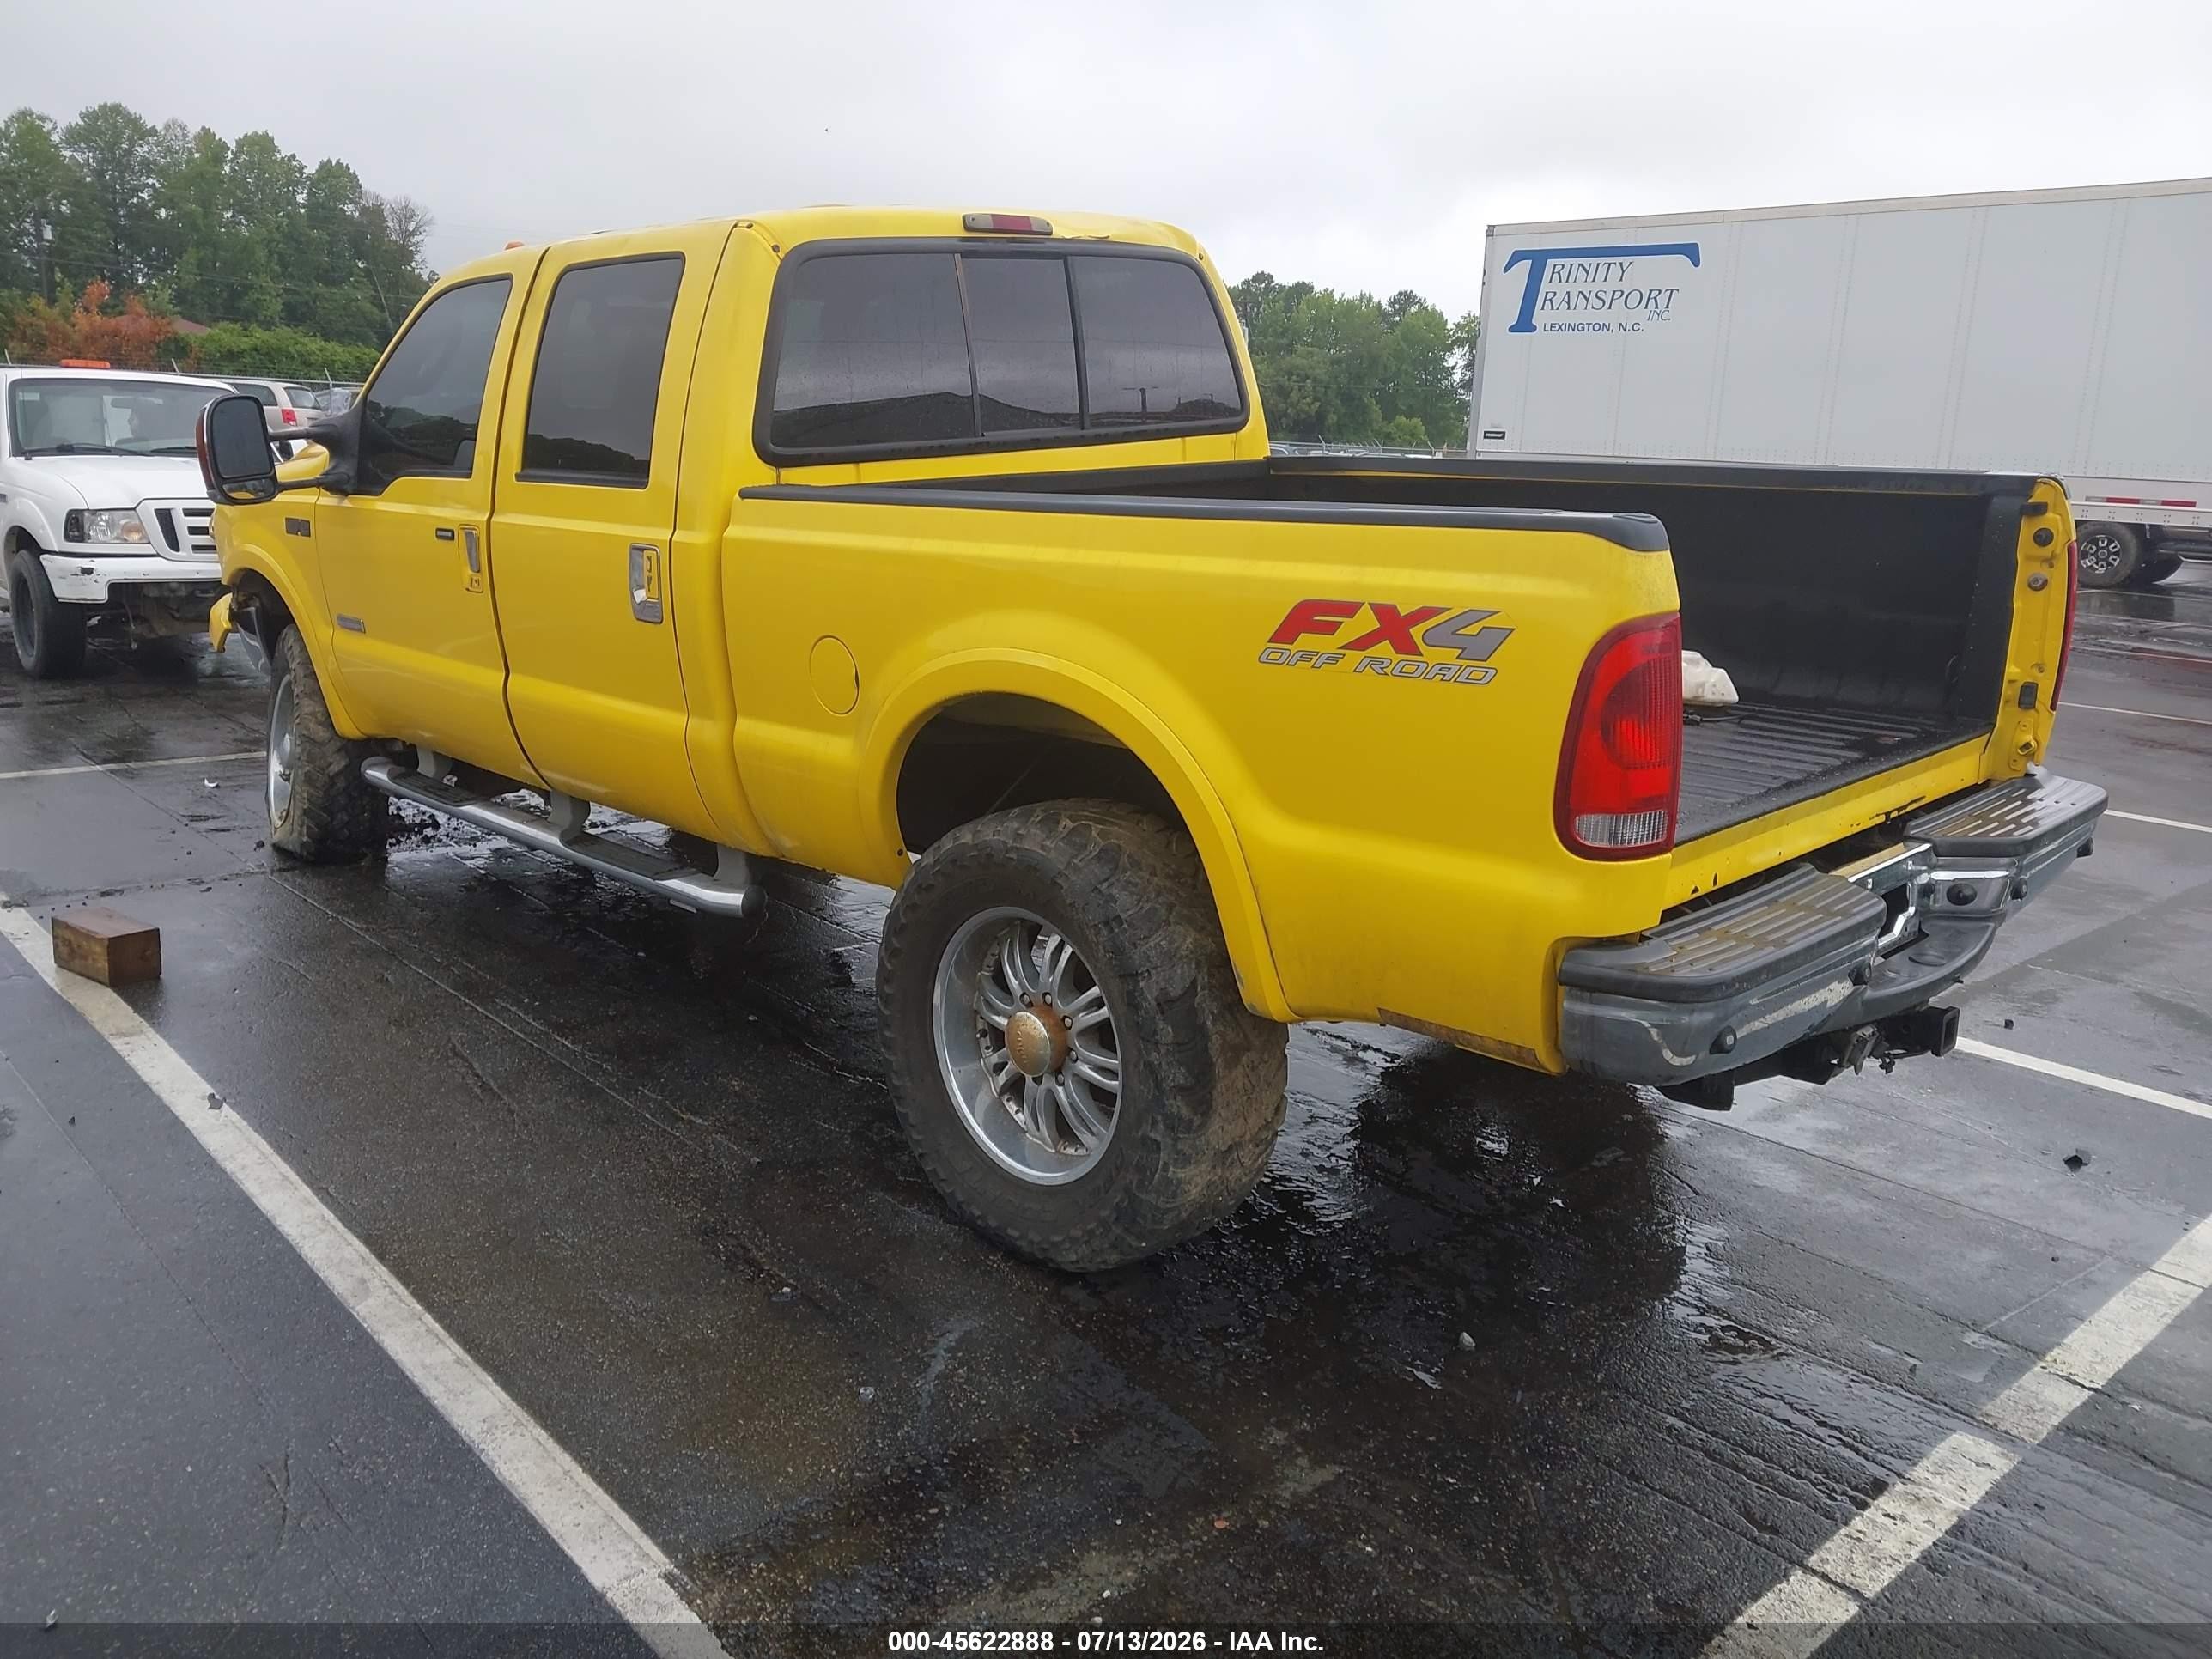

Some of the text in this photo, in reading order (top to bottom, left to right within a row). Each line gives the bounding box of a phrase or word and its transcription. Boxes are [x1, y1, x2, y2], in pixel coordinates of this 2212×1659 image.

[1543, 322, 1644, 333] LEXINGTON, N.C.
[1647, 309, 1671, 321] INC.
[1267, 599, 1516, 662] FX4
[1258, 647, 1498, 685] OFF ROAD
